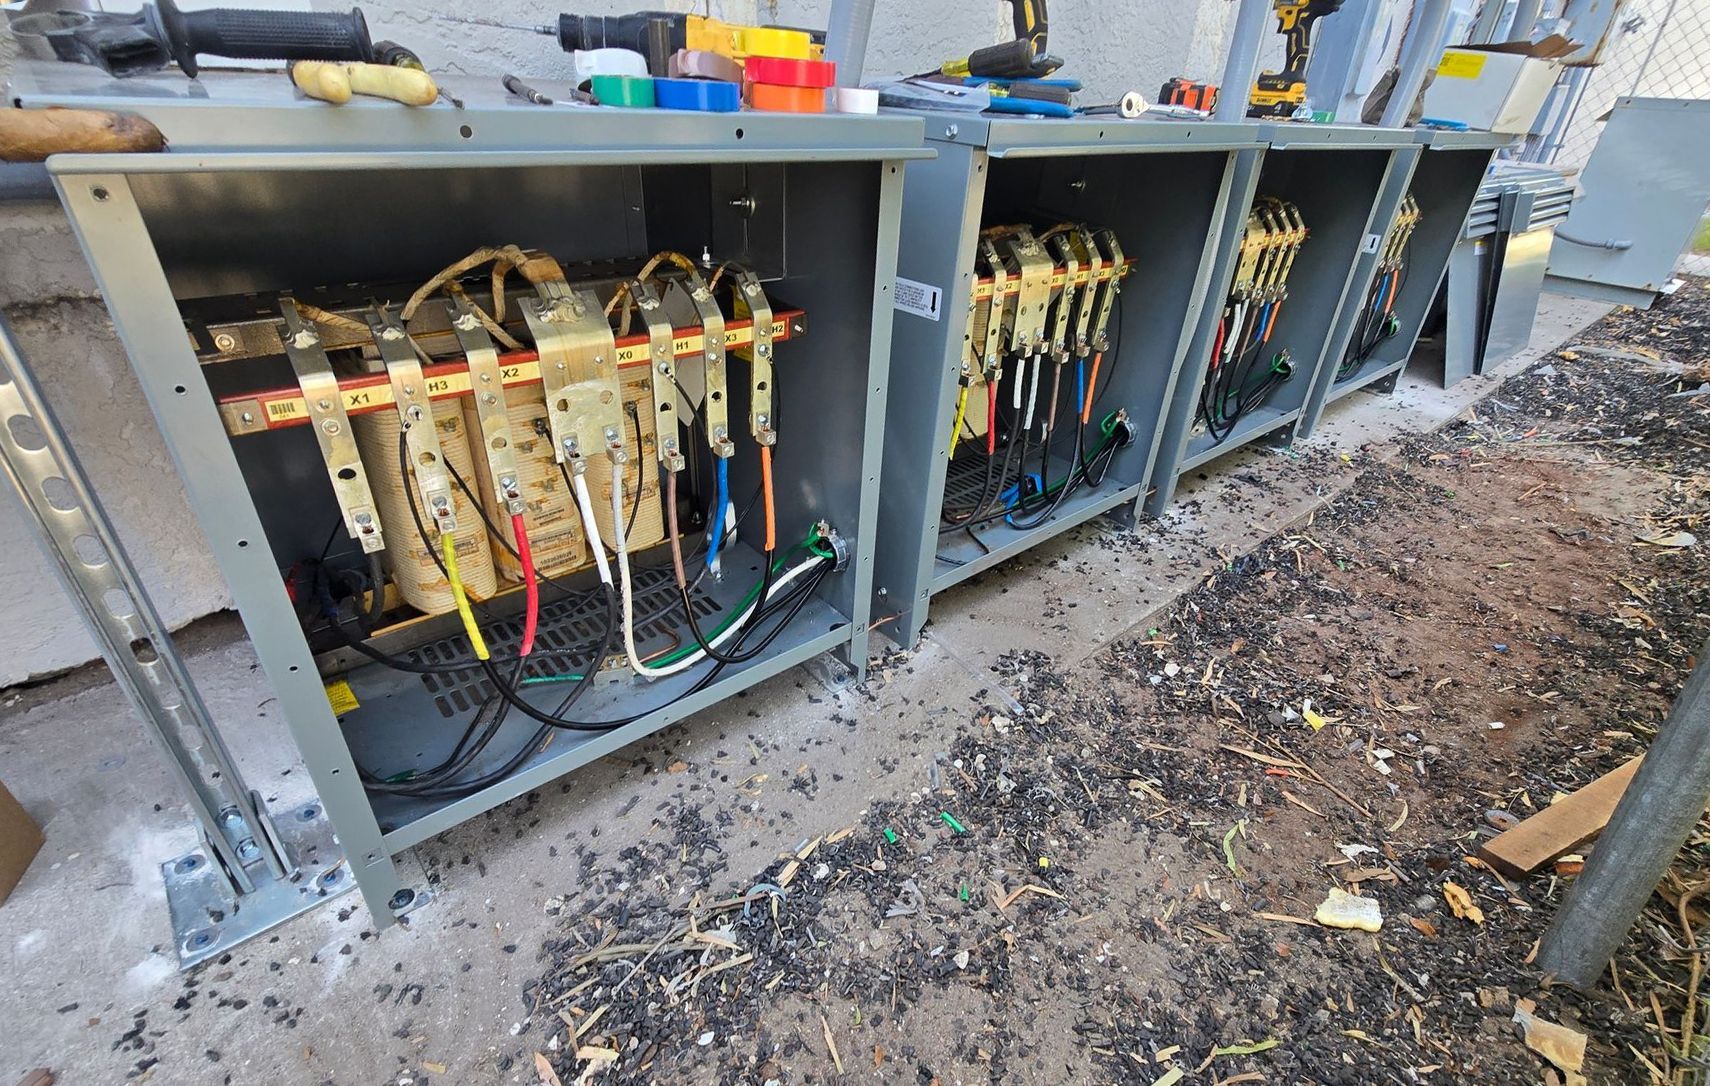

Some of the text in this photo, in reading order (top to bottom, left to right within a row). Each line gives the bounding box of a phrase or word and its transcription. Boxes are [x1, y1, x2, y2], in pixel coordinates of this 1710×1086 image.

[350, 323, 784, 406] X1 H3 X2 X0 H1 X3 H2
